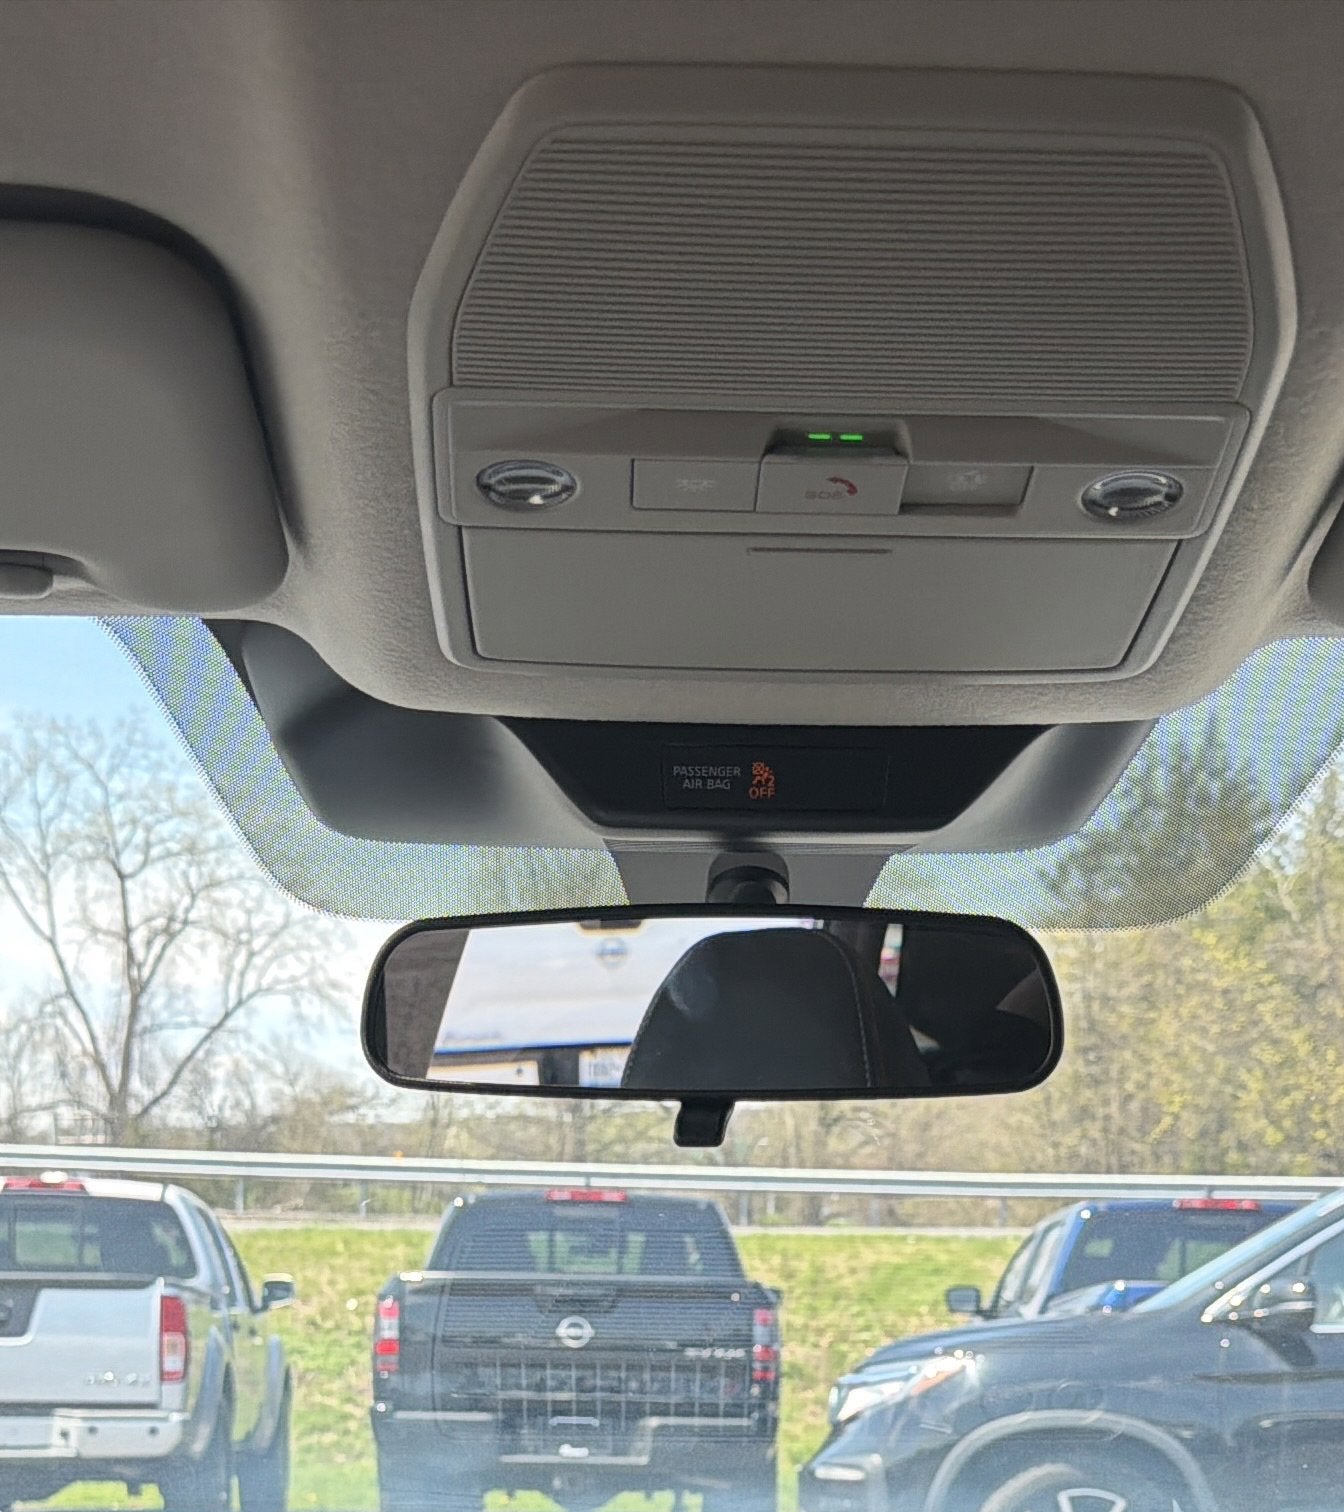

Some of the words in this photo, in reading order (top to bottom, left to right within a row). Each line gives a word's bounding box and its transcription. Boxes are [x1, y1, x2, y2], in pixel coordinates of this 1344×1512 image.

[673, 766, 741, 777] PASSENGER
[683, 779, 703, 789] AIR
[707, 778, 730, 790] BAG
[748, 787, 776, 799] OFF
